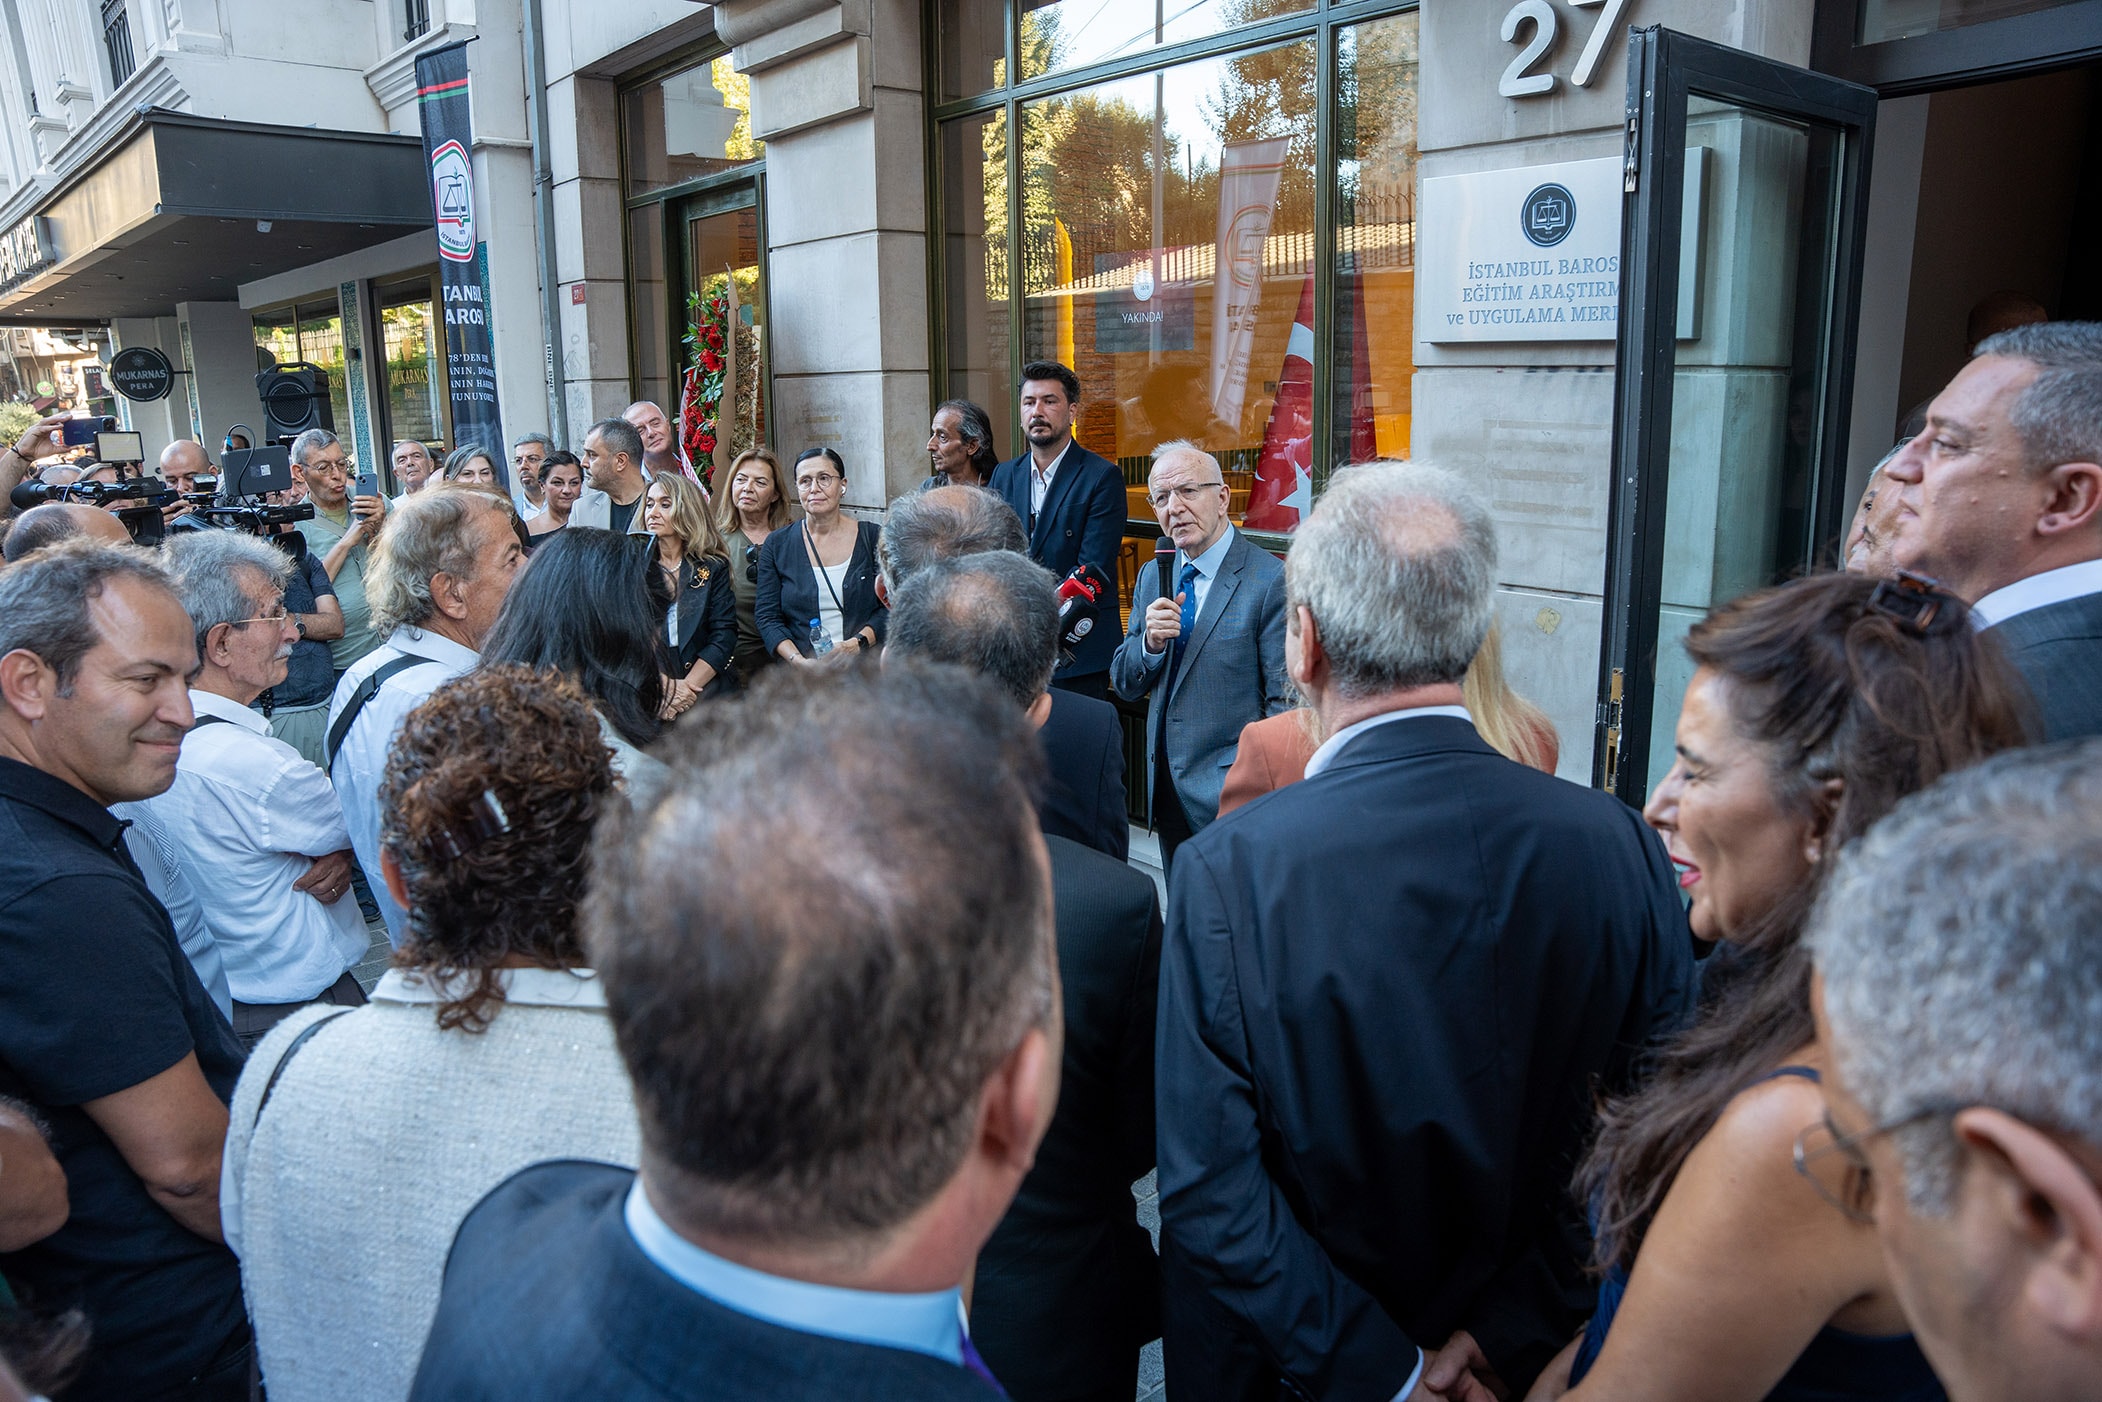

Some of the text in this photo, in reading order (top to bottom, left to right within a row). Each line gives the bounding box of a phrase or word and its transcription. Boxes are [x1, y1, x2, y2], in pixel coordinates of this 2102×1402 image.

[1498, 0, 1632, 98] 27
[1468, 255, 1619, 280] İSTANBUL BAROS
[1462, 280, 1620, 303] EĞİTİM ARAŞTIRM
[1121, 310, 1164, 324] YAKINDA!
[1446, 304, 1619, 326] ve UYGULAMA MER
[448, 353, 481, 363] 78'DEN
[116, 369, 167, 381] MUKARNAS
[390, 365, 430, 388] MUKARNAS
[130, 382, 154, 391] PERA
